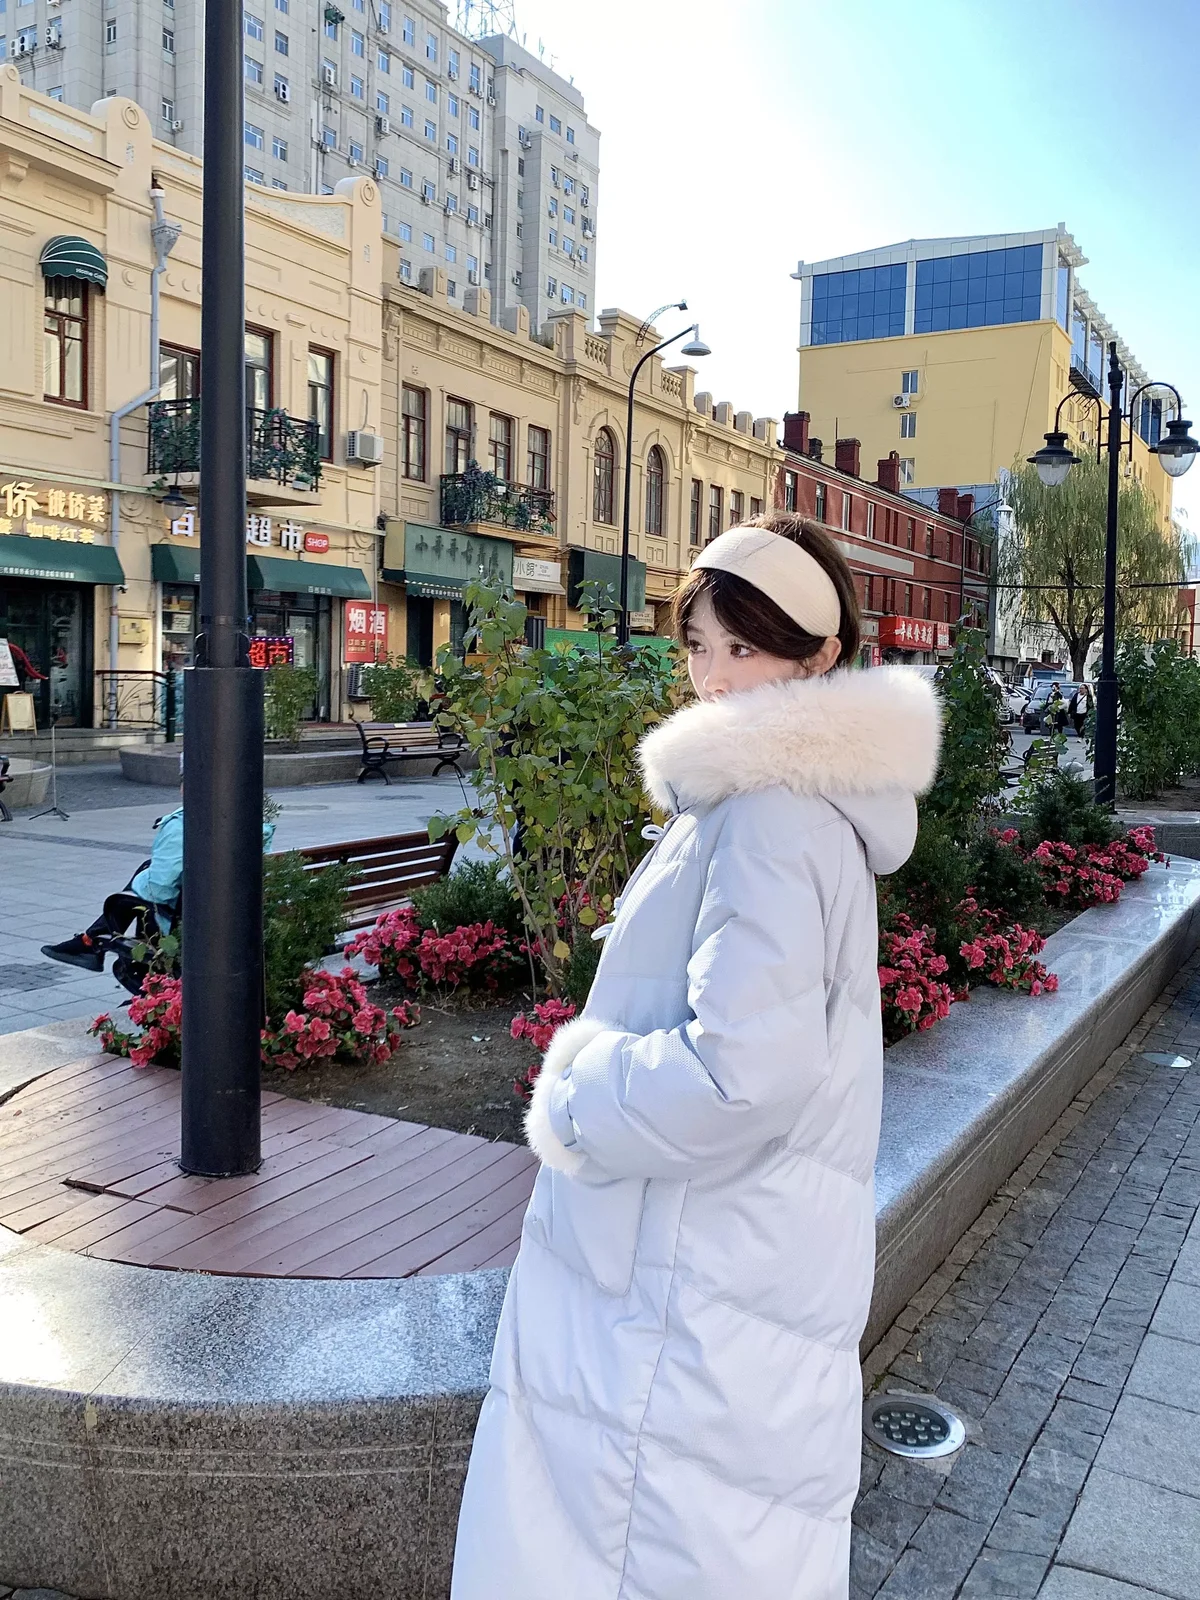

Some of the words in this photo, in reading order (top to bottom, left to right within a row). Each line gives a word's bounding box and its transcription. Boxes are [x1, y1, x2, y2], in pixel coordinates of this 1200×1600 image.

[171, 506, 304, 552] 百超市
[306, 537, 329, 548] SHOP
[348, 607, 386, 636] 烟酒
[249, 641, 289, 667] 超市
